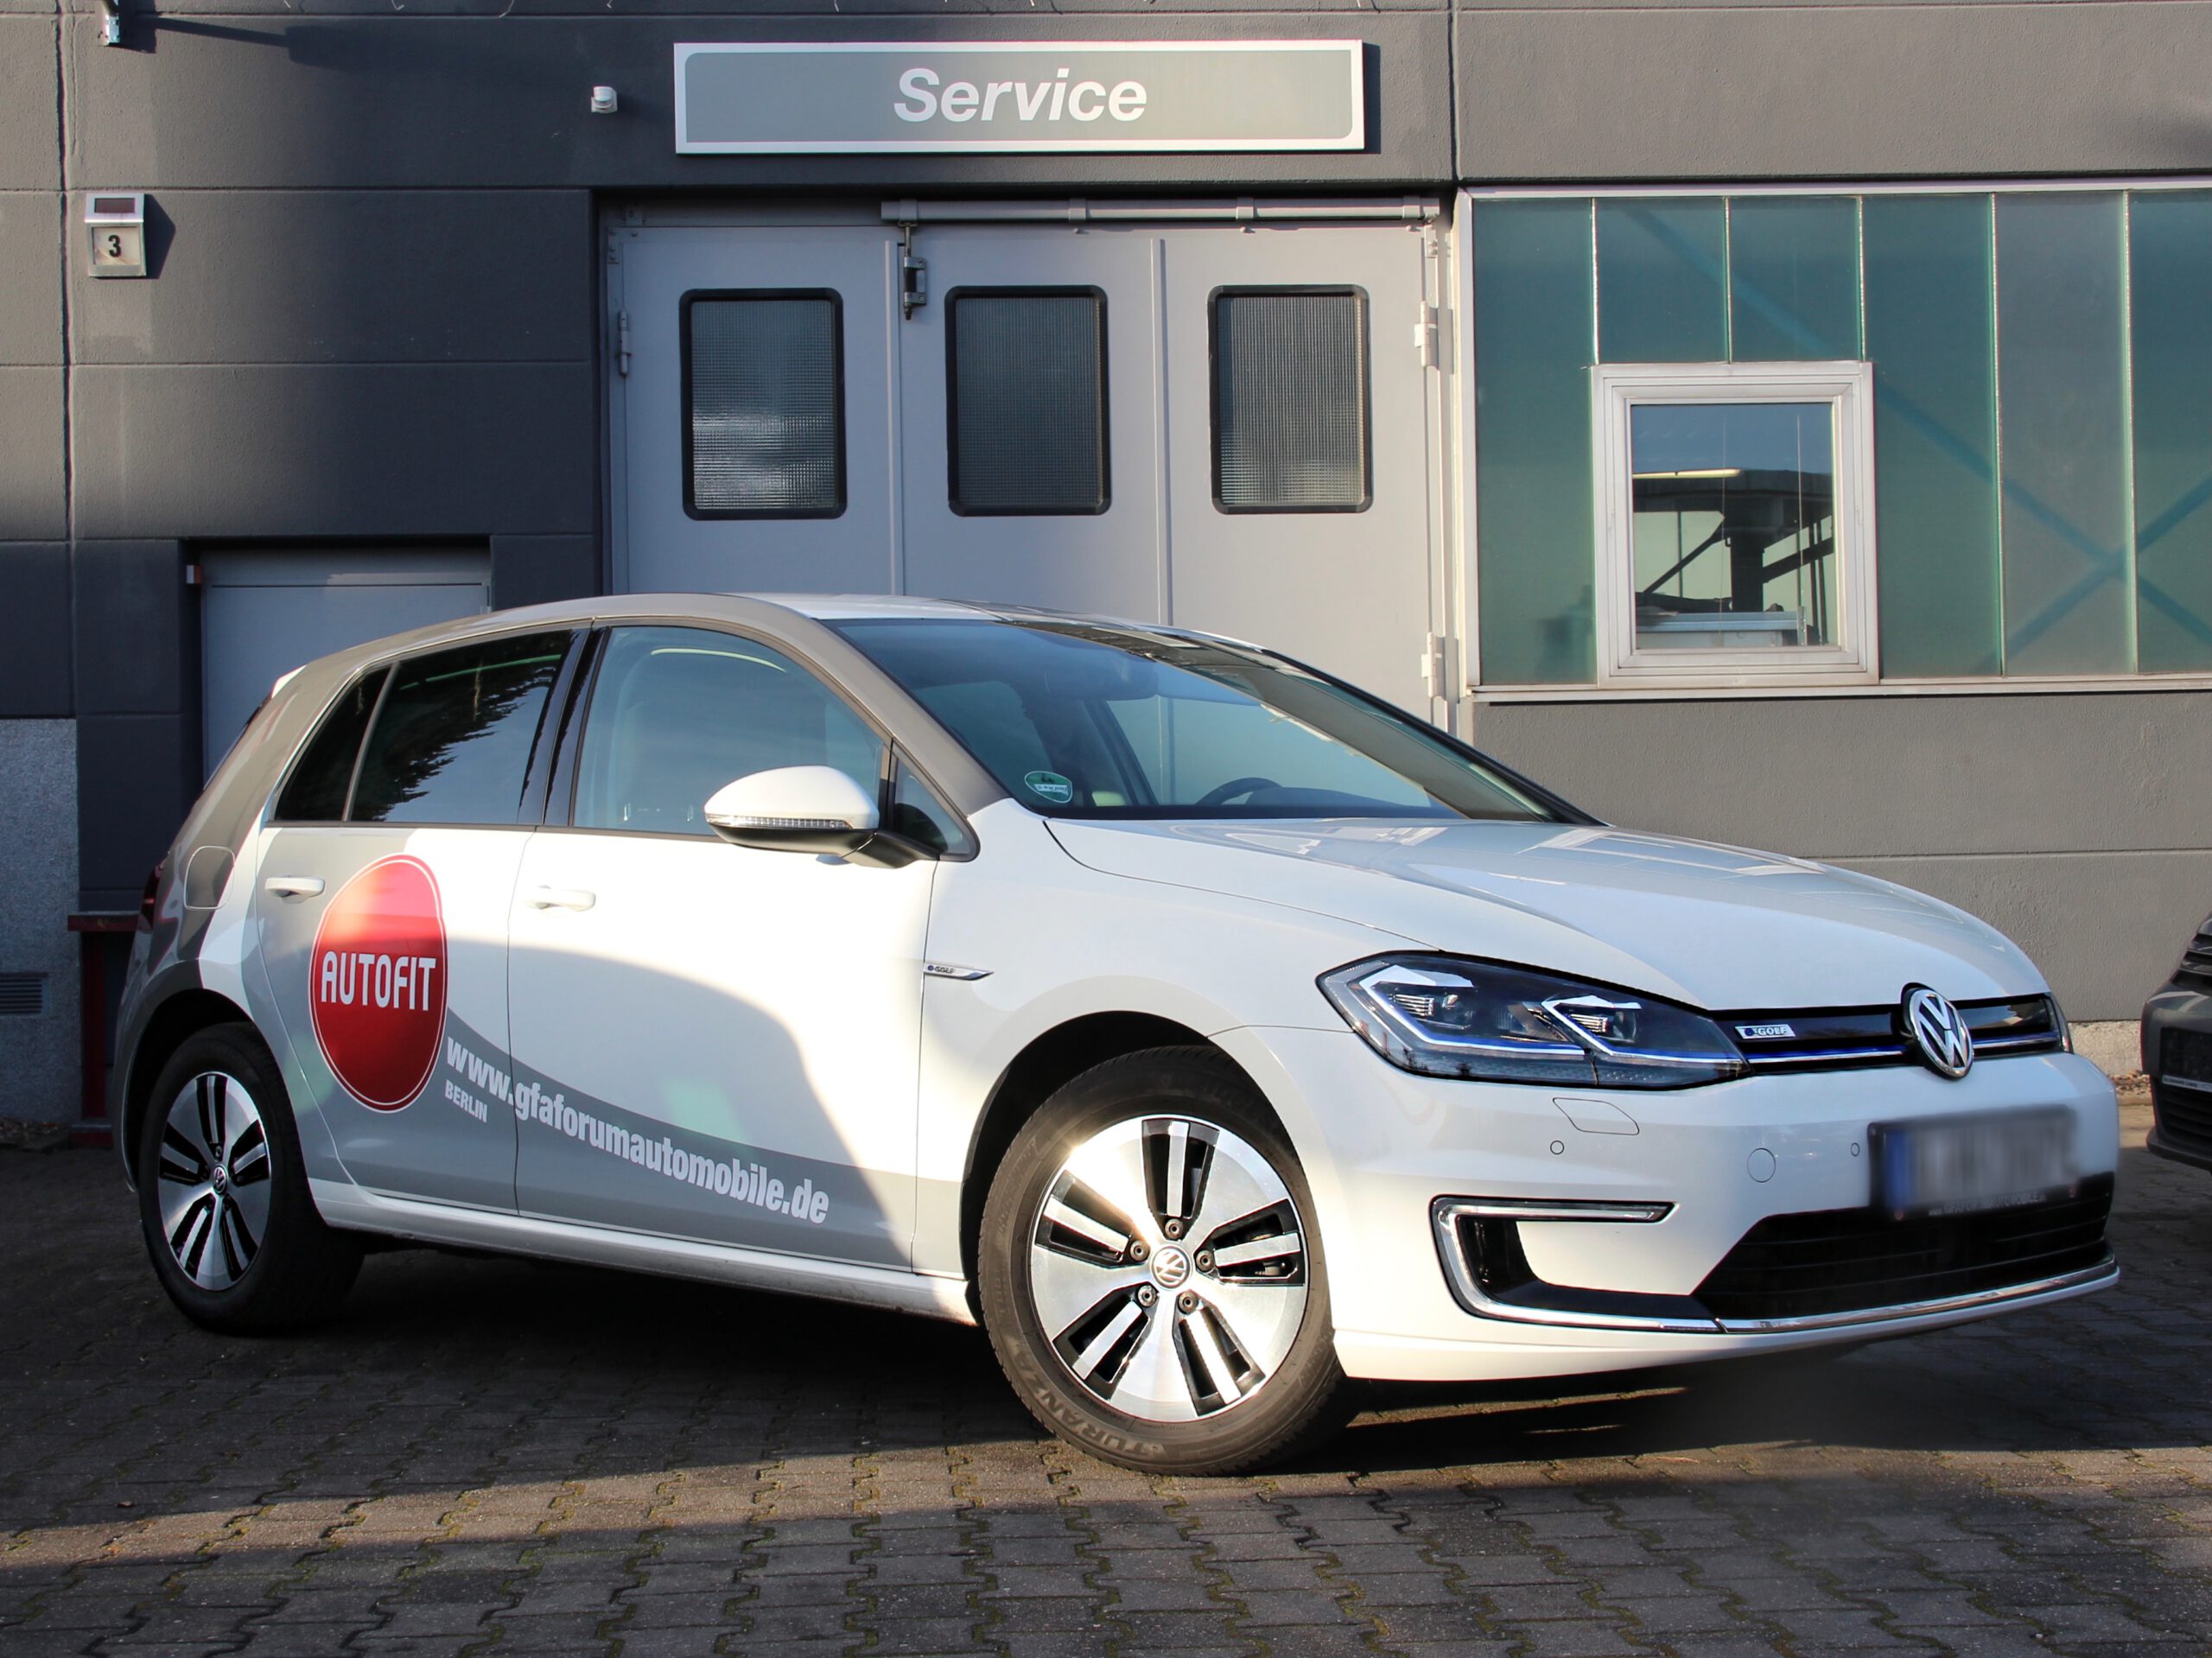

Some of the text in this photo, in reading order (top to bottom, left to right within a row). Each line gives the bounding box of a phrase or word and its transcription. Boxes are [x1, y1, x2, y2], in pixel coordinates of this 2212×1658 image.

[893, 67, 1147, 123] Service
[108, 234, 122, 257] 3
[321, 950, 436, 1011] AUTOFIT
[444, 1079, 488, 1123] BERLIN
[446, 1037, 830, 1224] www.gfaforumautomobile.de
